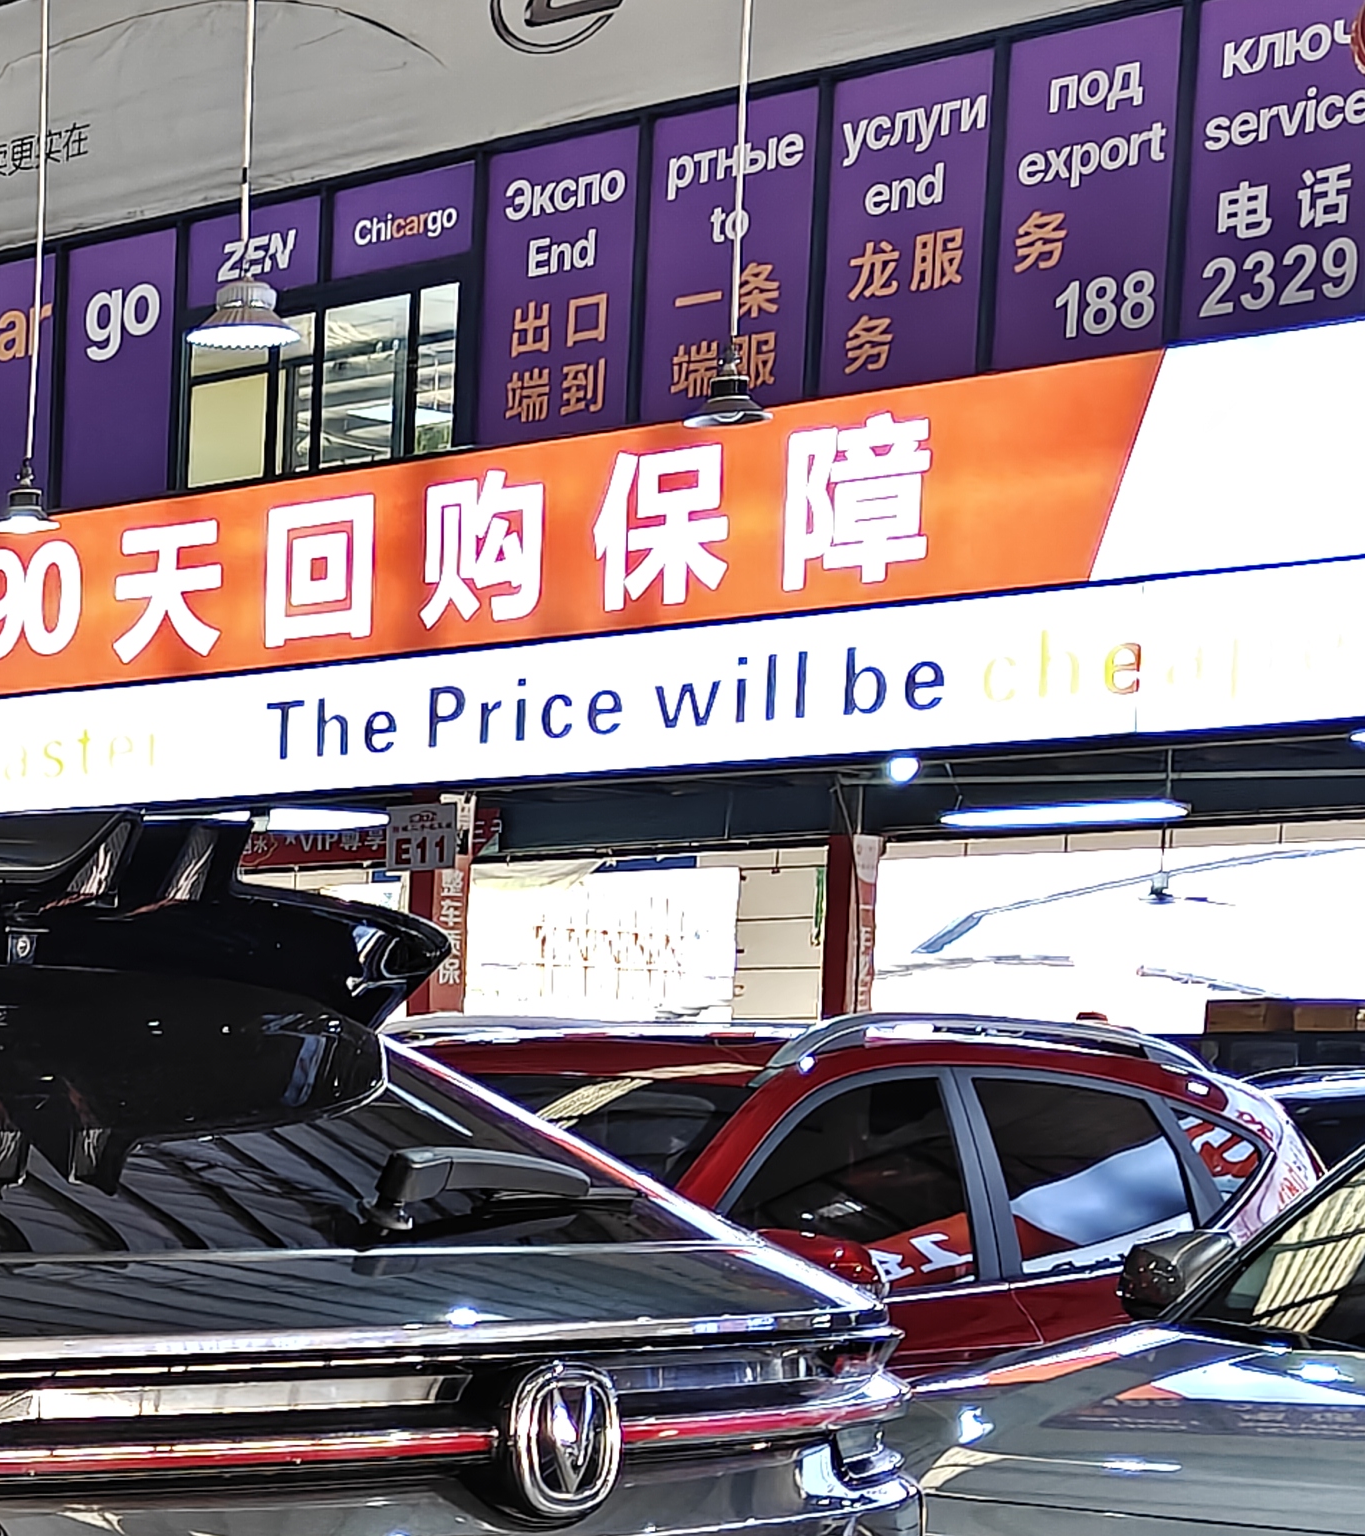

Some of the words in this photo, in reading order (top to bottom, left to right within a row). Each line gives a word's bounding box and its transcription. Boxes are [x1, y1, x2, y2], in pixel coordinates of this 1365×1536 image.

[504, 168, 627, 222] Экспо
[667, 130, 806, 202] ртные
[842, 92, 988, 167] услуги
[1048, 61, 1145, 113] под
[526, 228, 597, 278] End
[710, 203, 749, 246] to
[863, 162, 945, 217] end
[1017, 120, 1168, 189] export
[1203, 86, 1365, 151] service
[353, 207, 459, 246] Chicargo
[1216, 162, 1354, 240] 电话
[511, 293, 608, 360] 出口
[847, 227, 964, 301] 龙服
[1014, 211, 1069, 273] 务
[1054, 269, 1157, 339] 188
[1199, 236, 1360, 318] 2329
[505, 359, 606, 424] 端到
[845, 315, 895, 375] 务
[267, 698, 398, 760] The
[427, 677, 624, 749] Price
[654, 654, 809, 729] will
[842, 646, 945, 717] be
[395, 834, 446, 865] E11
